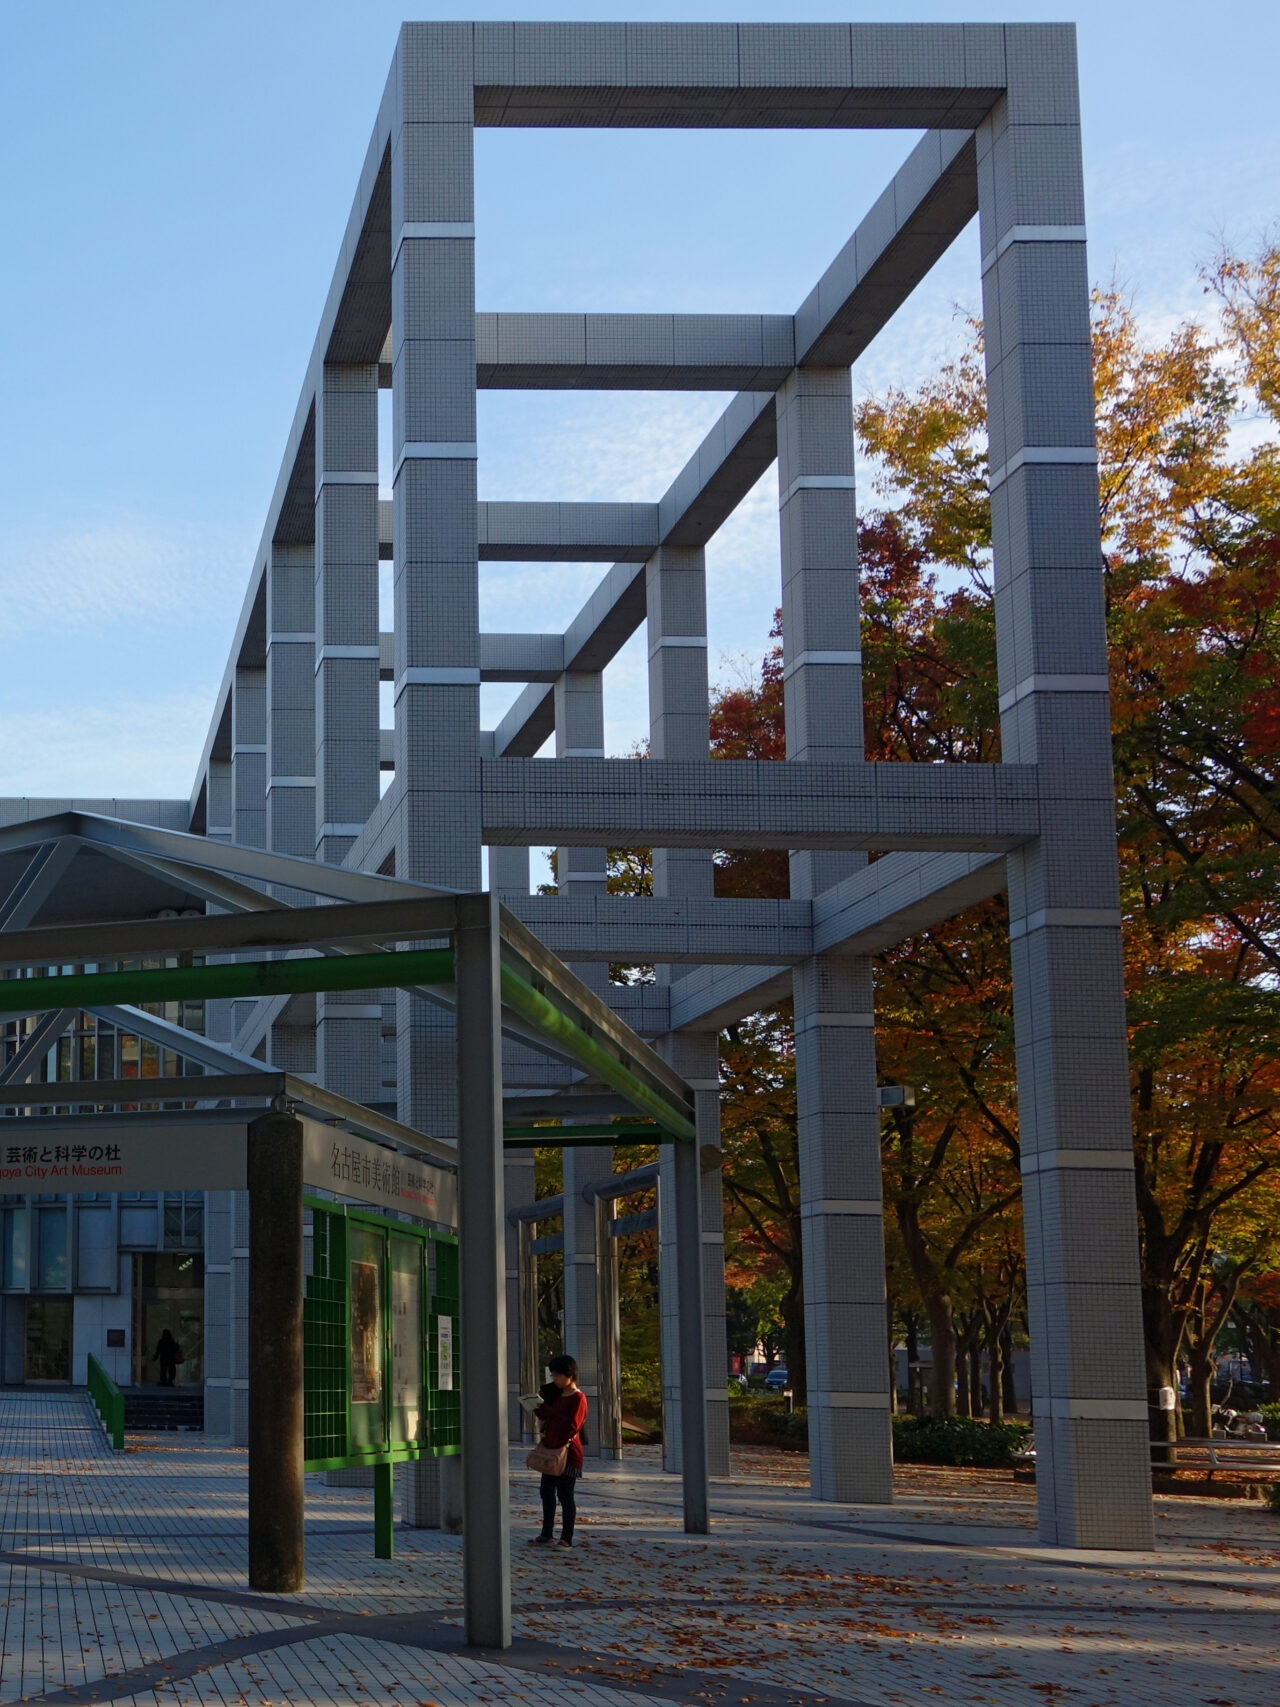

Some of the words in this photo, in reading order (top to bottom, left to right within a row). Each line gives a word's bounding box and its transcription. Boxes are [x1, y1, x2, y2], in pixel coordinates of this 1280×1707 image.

[6, 1144, 121, 1164] 芸術と科学の杜
[24, 1164, 47, 1179] City
[50, 1164, 68, 1177] Art
[72, 1164, 122, 1177] Museum
[331, 1142, 400, 1197] 名古屋市美術館
